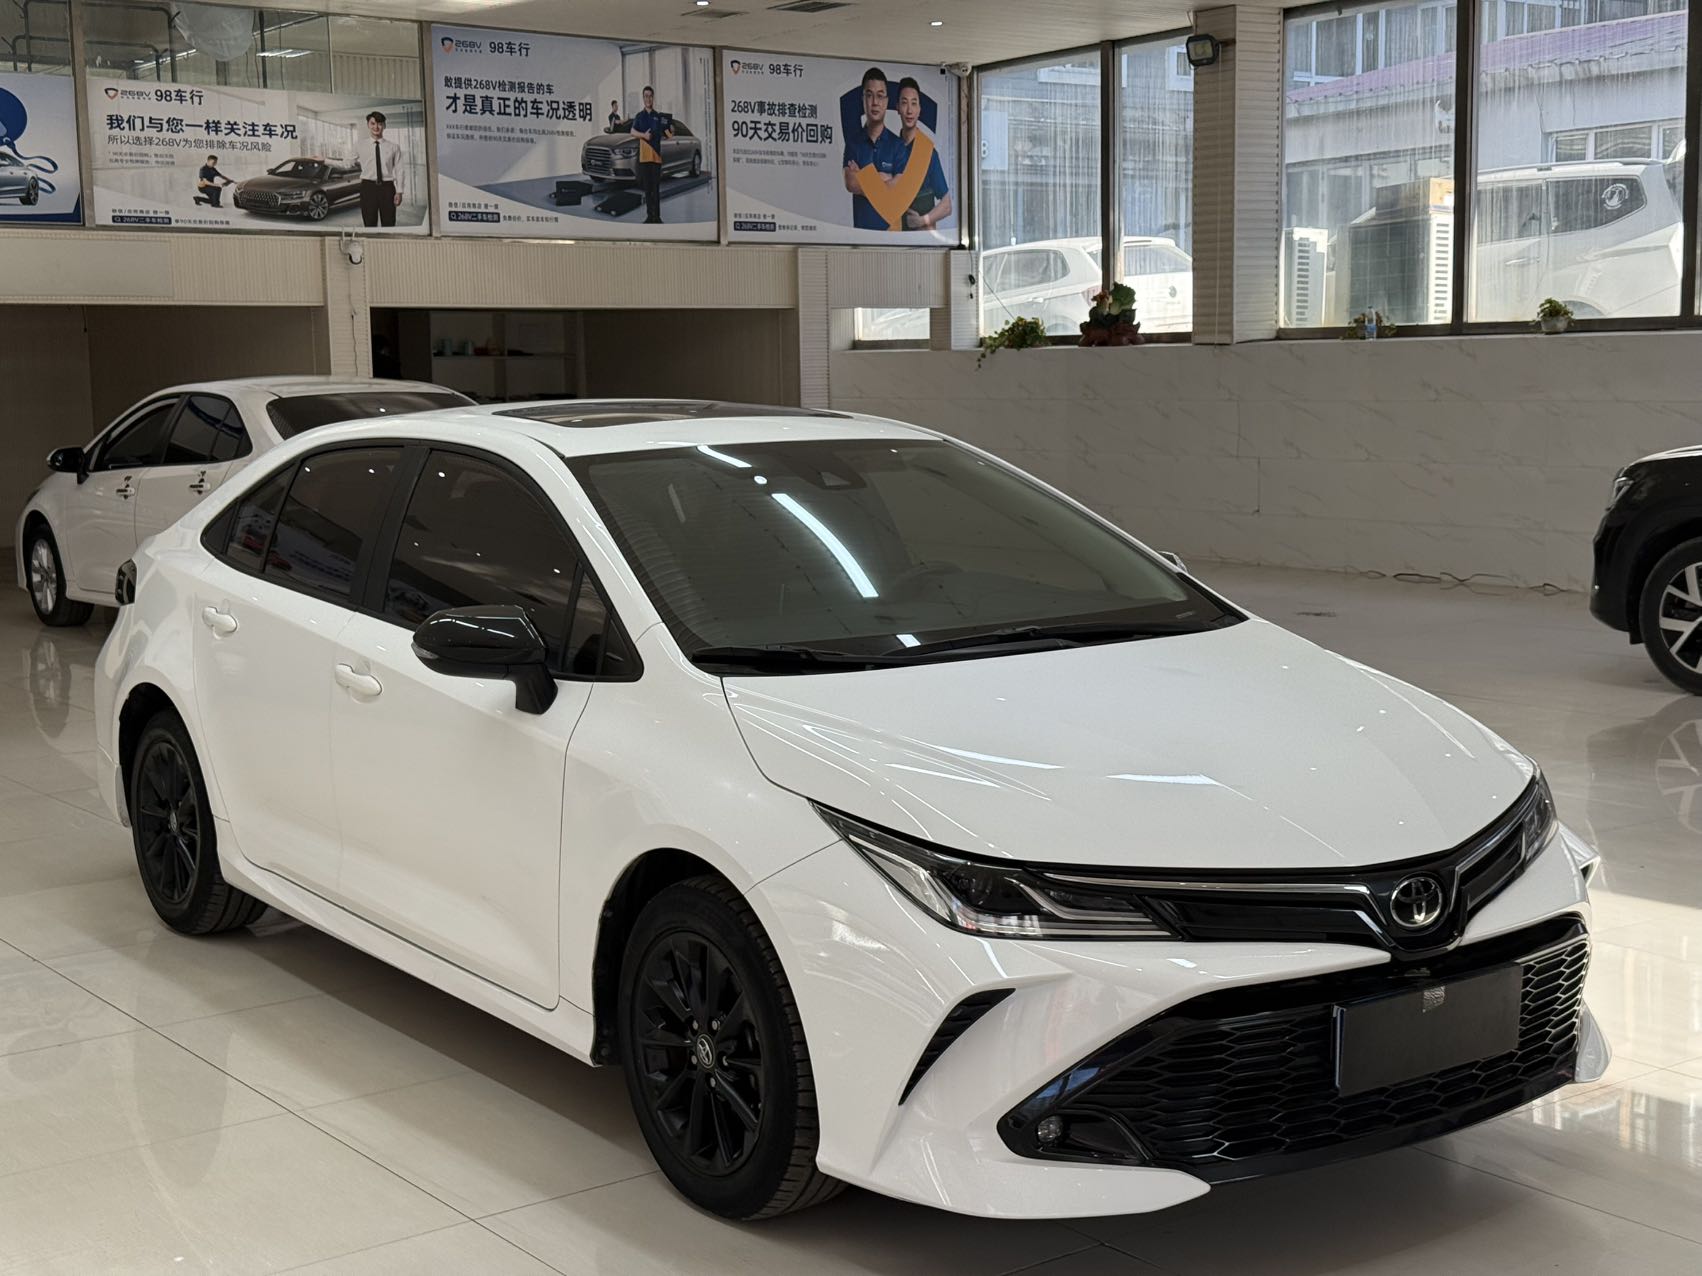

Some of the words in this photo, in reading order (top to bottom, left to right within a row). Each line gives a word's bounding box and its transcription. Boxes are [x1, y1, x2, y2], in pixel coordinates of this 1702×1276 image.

[489, 41, 530, 57] 98车行
[769, 62, 804, 77] 98车行
[444, 75, 554, 95] 敢提供268V检测报告的车
[155, 88, 203, 105] 98车行
[446, 93, 593, 122] 才是真正的车况透明
[731, 100, 818, 119] 268V事故排查检测
[106, 114, 298, 140] 我们与您一样关注车况
[732, 120, 833, 144] 90天交易价回购
[107, 134, 272, 153] 所以选择268V为您排除车况风险
